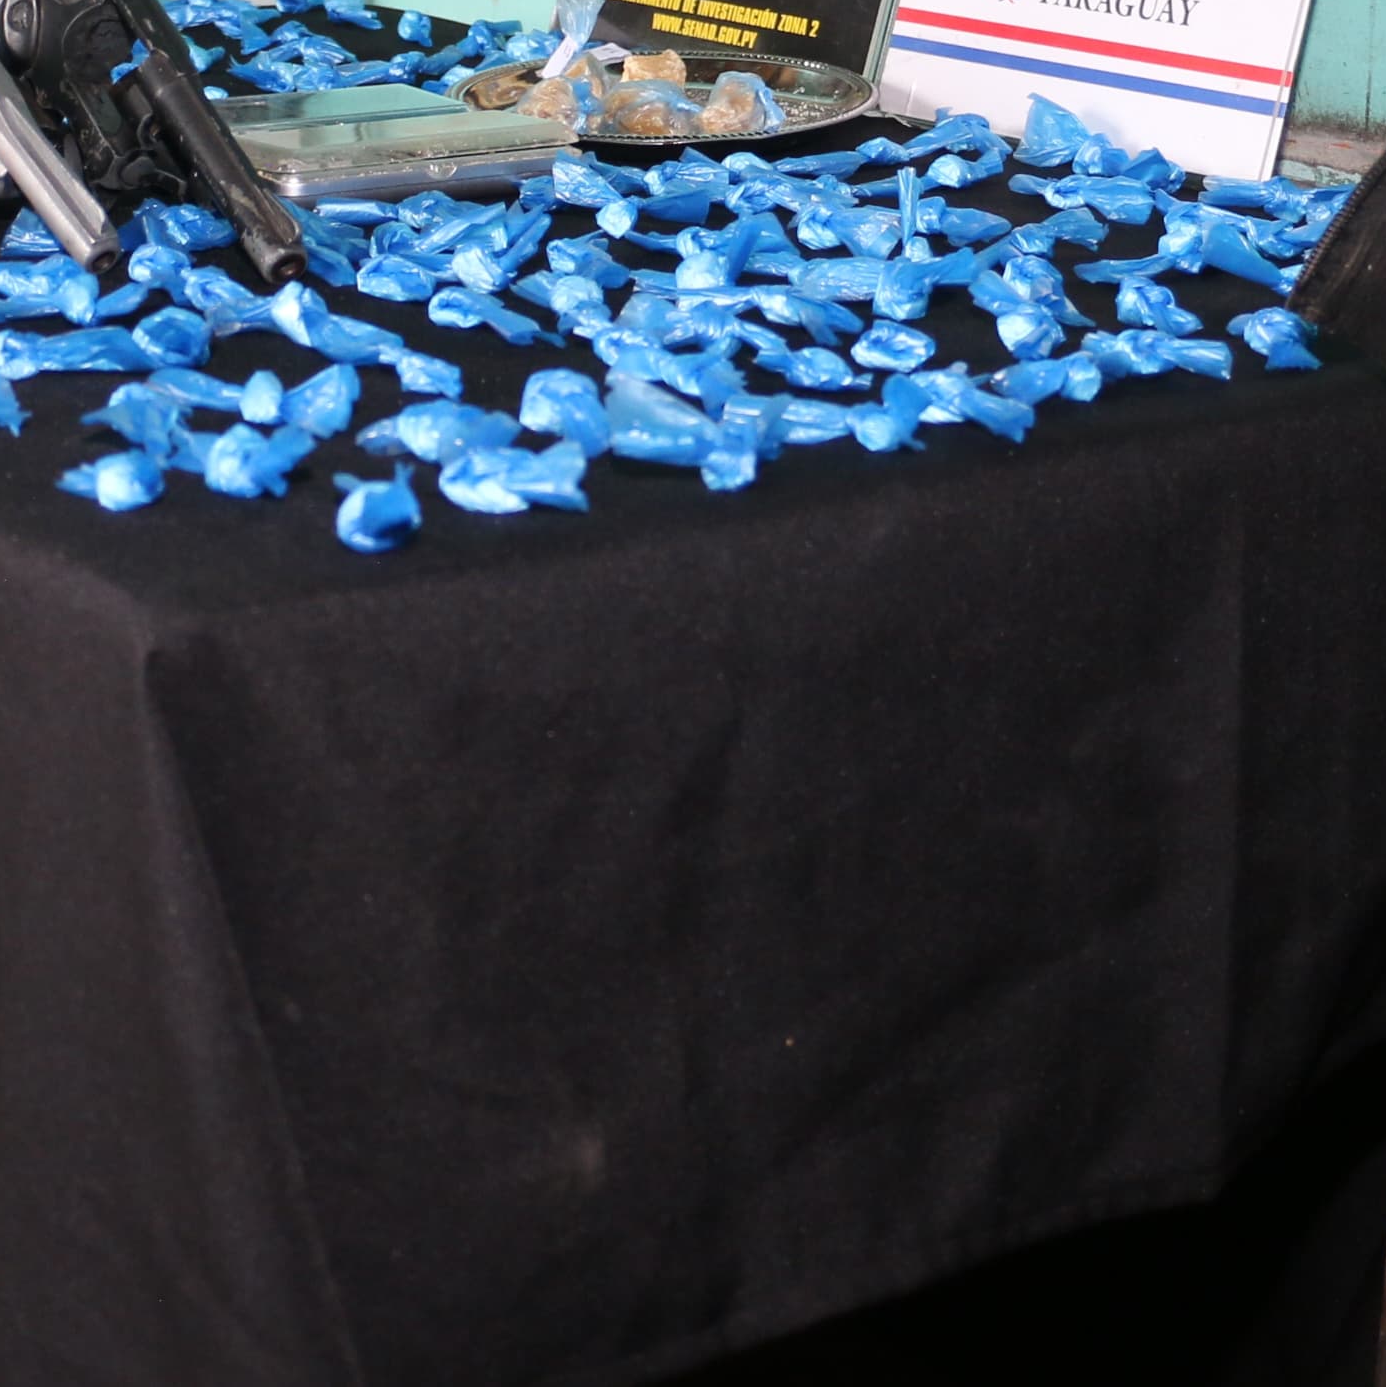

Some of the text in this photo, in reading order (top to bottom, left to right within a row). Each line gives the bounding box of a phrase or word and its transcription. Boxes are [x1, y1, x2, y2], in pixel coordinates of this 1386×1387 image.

[652, 13, 758, 49] WWW.SENAD.GOV.PY
[778, 14, 808, 36] ZONA
[809, 20, 820, 37] 2
